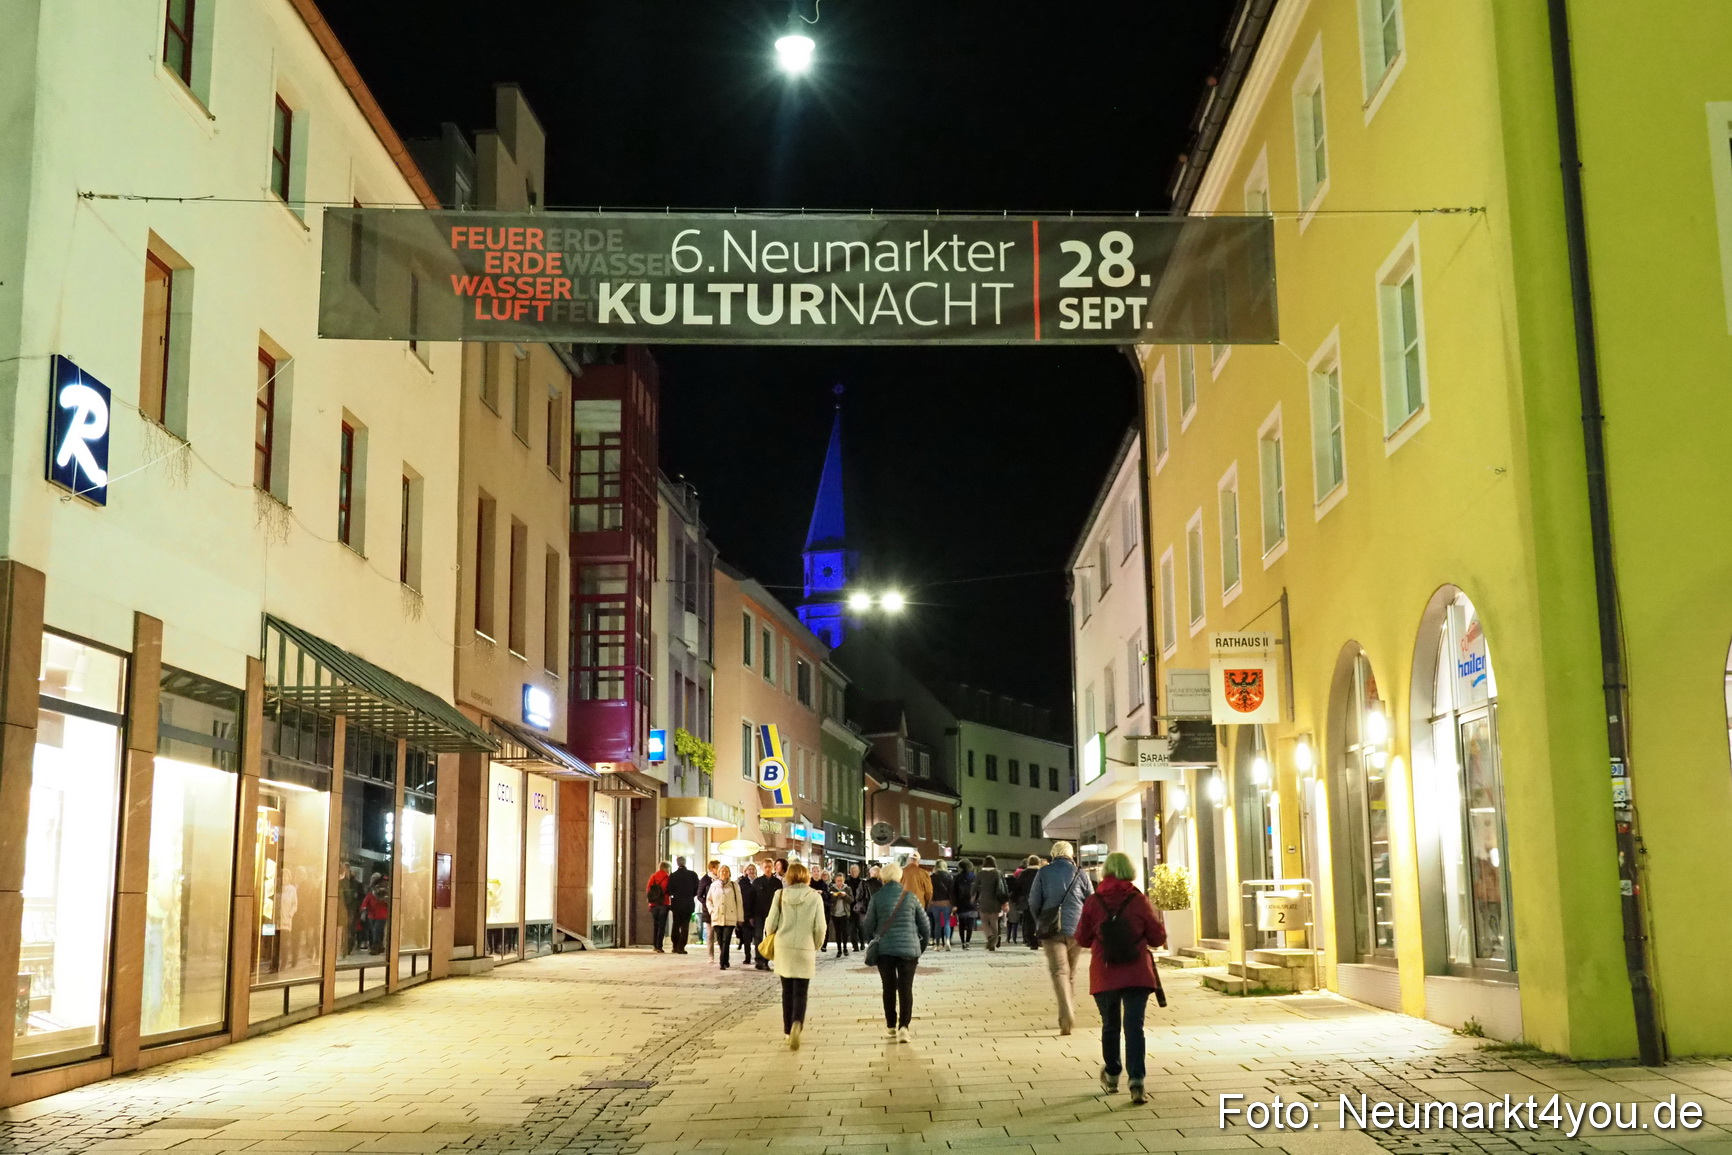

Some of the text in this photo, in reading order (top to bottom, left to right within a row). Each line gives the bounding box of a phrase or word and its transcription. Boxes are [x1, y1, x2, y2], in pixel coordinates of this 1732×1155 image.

[451, 226, 545, 250] FEUER
[485, 251, 563, 275] ERDE
[1058, 230, 1151, 288] 28.
[450, 273, 573, 300] WASSER
[475, 297, 551, 322] LUFT
[597, 281, 1015, 326] KULTURNACHT
[1058, 296, 1154, 330] SEPT.
[57, 383, 109, 488] R
[1215, 637, 1269, 648] RATHAUS II
[763, 765, 779, 781] B
[1277, 912, 1286, 924] 2
